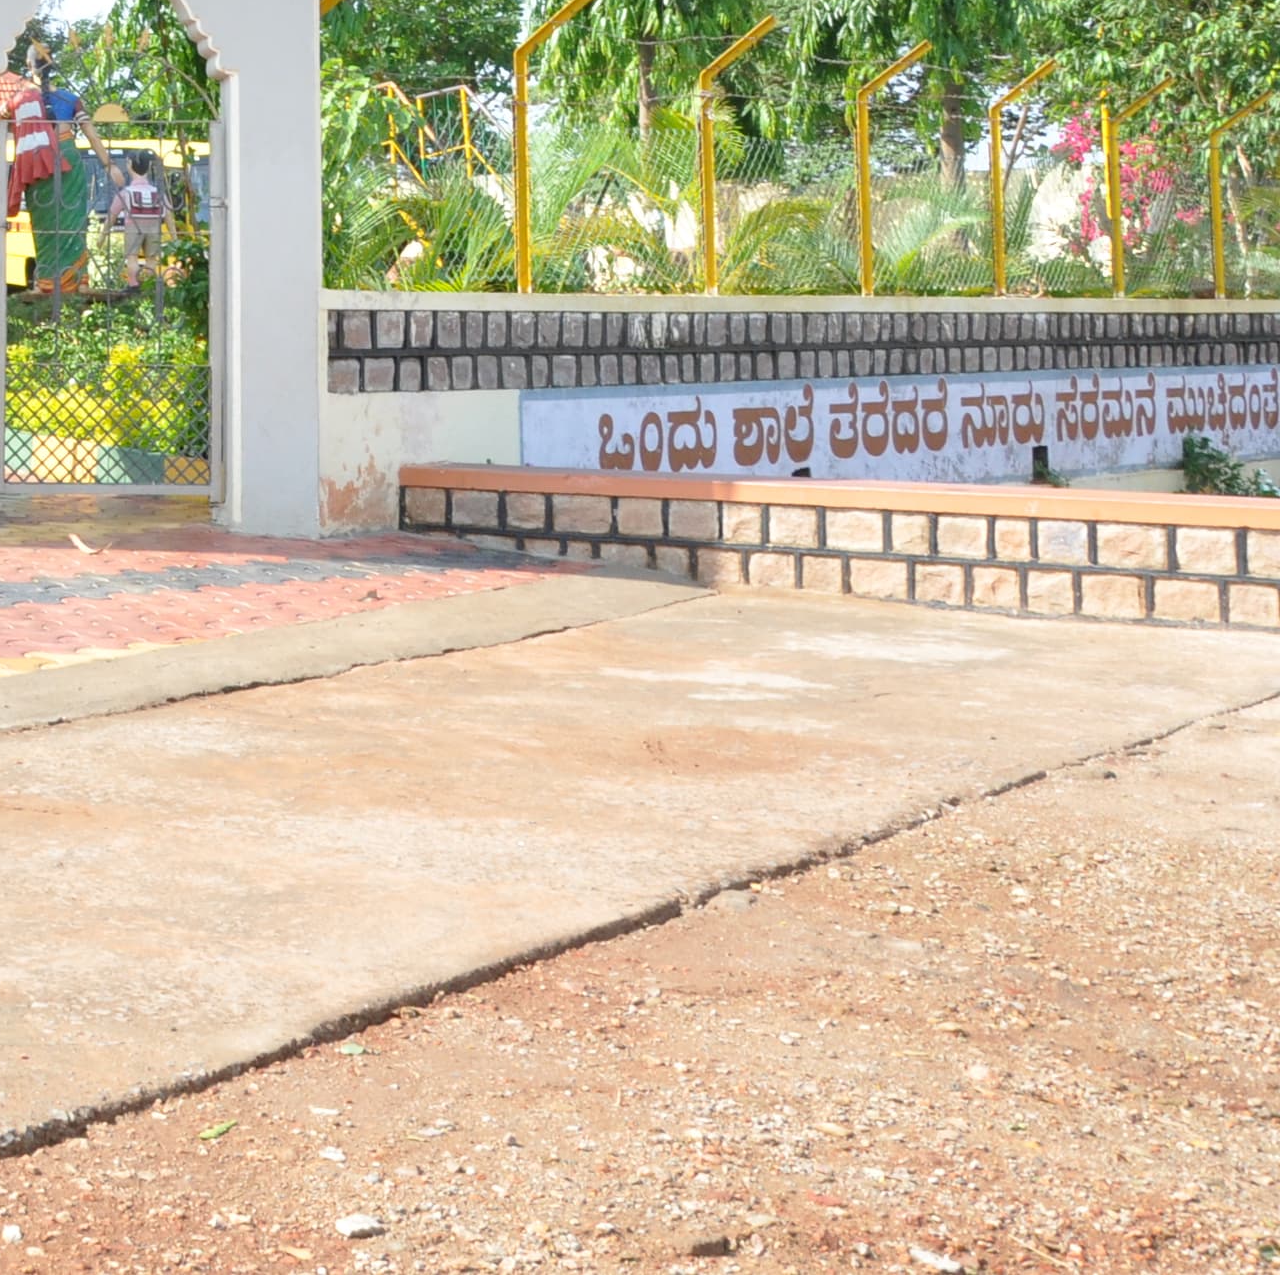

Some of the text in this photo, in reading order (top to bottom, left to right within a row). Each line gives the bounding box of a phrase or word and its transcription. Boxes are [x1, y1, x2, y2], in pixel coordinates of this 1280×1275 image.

[598, 396, 717, 472] ಒಂದು
[733, 383, 814, 467] ಶಾಲೆ
[829, 377, 948, 460] ತೆರೆದರೆ
[961, 381, 1045, 449] ನೂರು
[1056, 373, 1156, 442] ಸೆರೆಮನೆ
